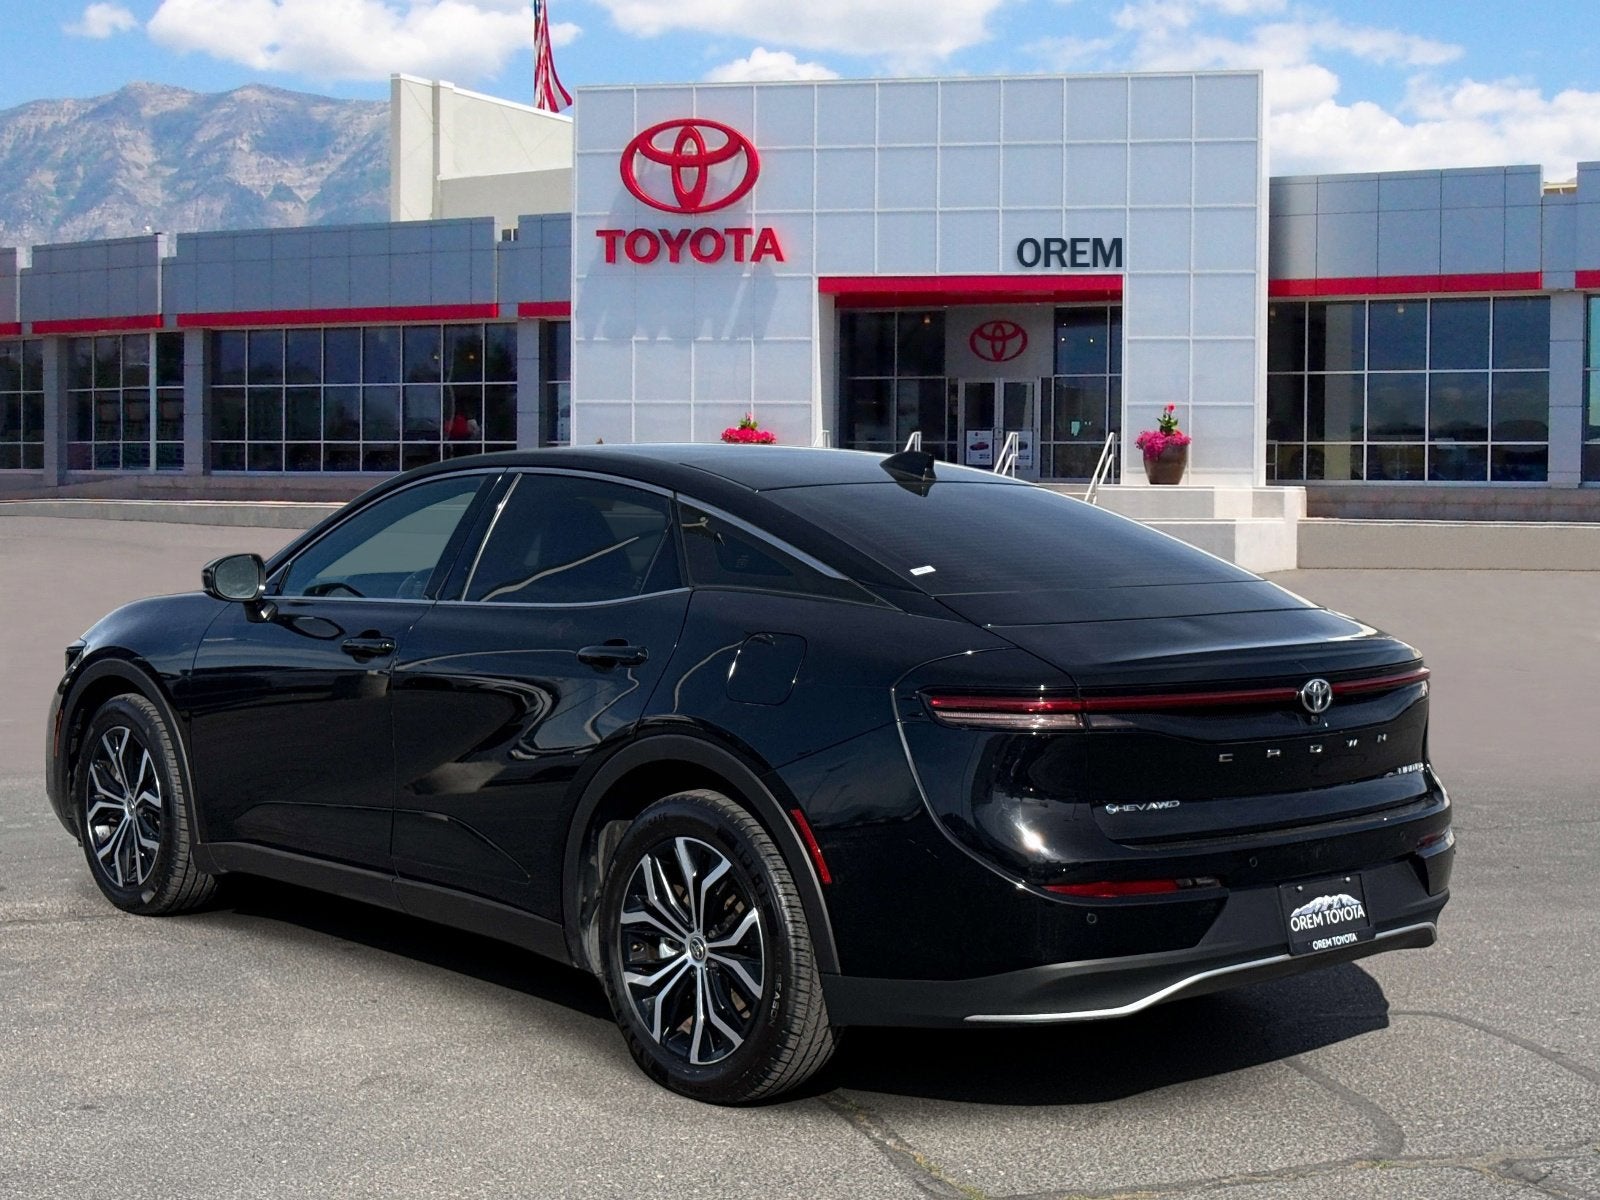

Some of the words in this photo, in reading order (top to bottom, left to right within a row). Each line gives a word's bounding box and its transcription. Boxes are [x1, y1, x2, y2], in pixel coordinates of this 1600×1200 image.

[596, 227, 785, 264] TOYOTA
[1016, 237, 1124, 269] OREM
[1218, 733, 1388, 763] CROWN
[1290, 911, 1324, 932] OREM
[1324, 904, 1366, 925] TOYOTA
[1312, 938, 1333, 950] OREM
[1332, 932, 1359, 946] TOYOTA
